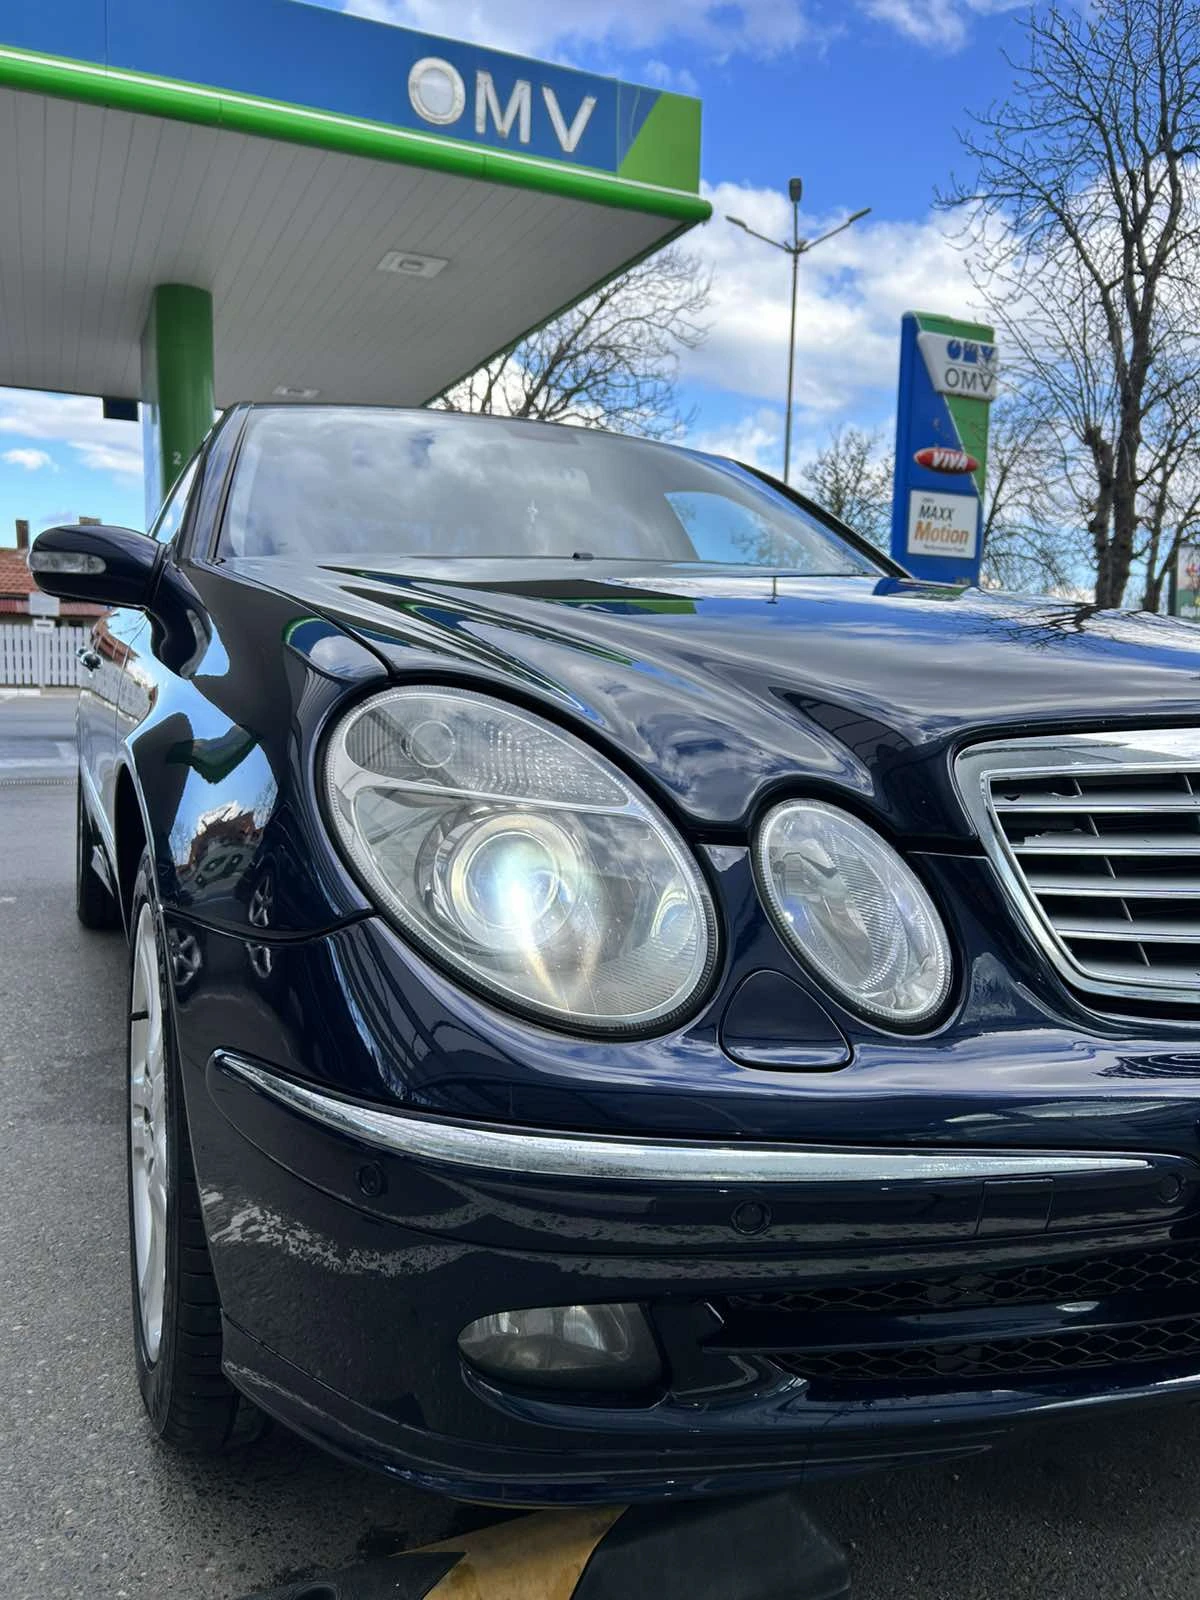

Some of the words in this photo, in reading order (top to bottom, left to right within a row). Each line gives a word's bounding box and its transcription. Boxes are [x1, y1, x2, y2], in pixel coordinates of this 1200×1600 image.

[408, 57, 597, 153] OMV
[945, 367, 994, 392] OMV
[931, 450, 968, 471] VIVA
[918, 504, 956, 522] MAXX
[914, 519, 970, 545] Motion
